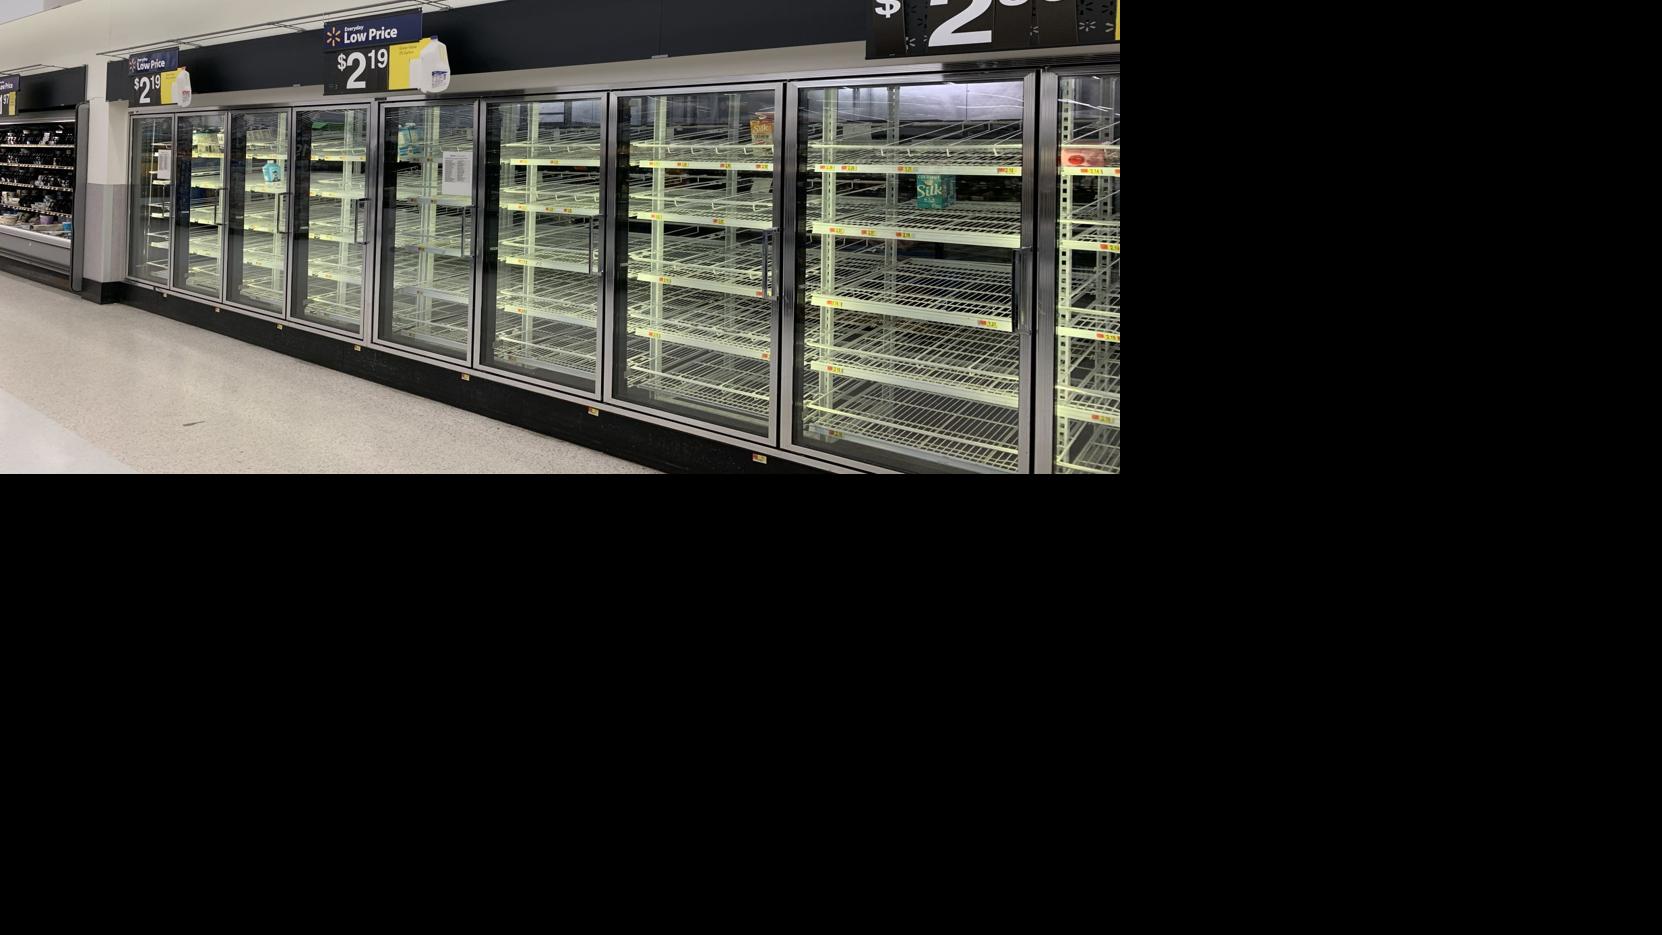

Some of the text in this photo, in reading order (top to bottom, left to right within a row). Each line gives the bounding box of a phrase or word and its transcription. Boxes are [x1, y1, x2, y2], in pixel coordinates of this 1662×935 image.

[344, 27, 398, 43] Low Price
[137, 59, 165, 71] Low Price
[917, 184, 943, 199] Silk
